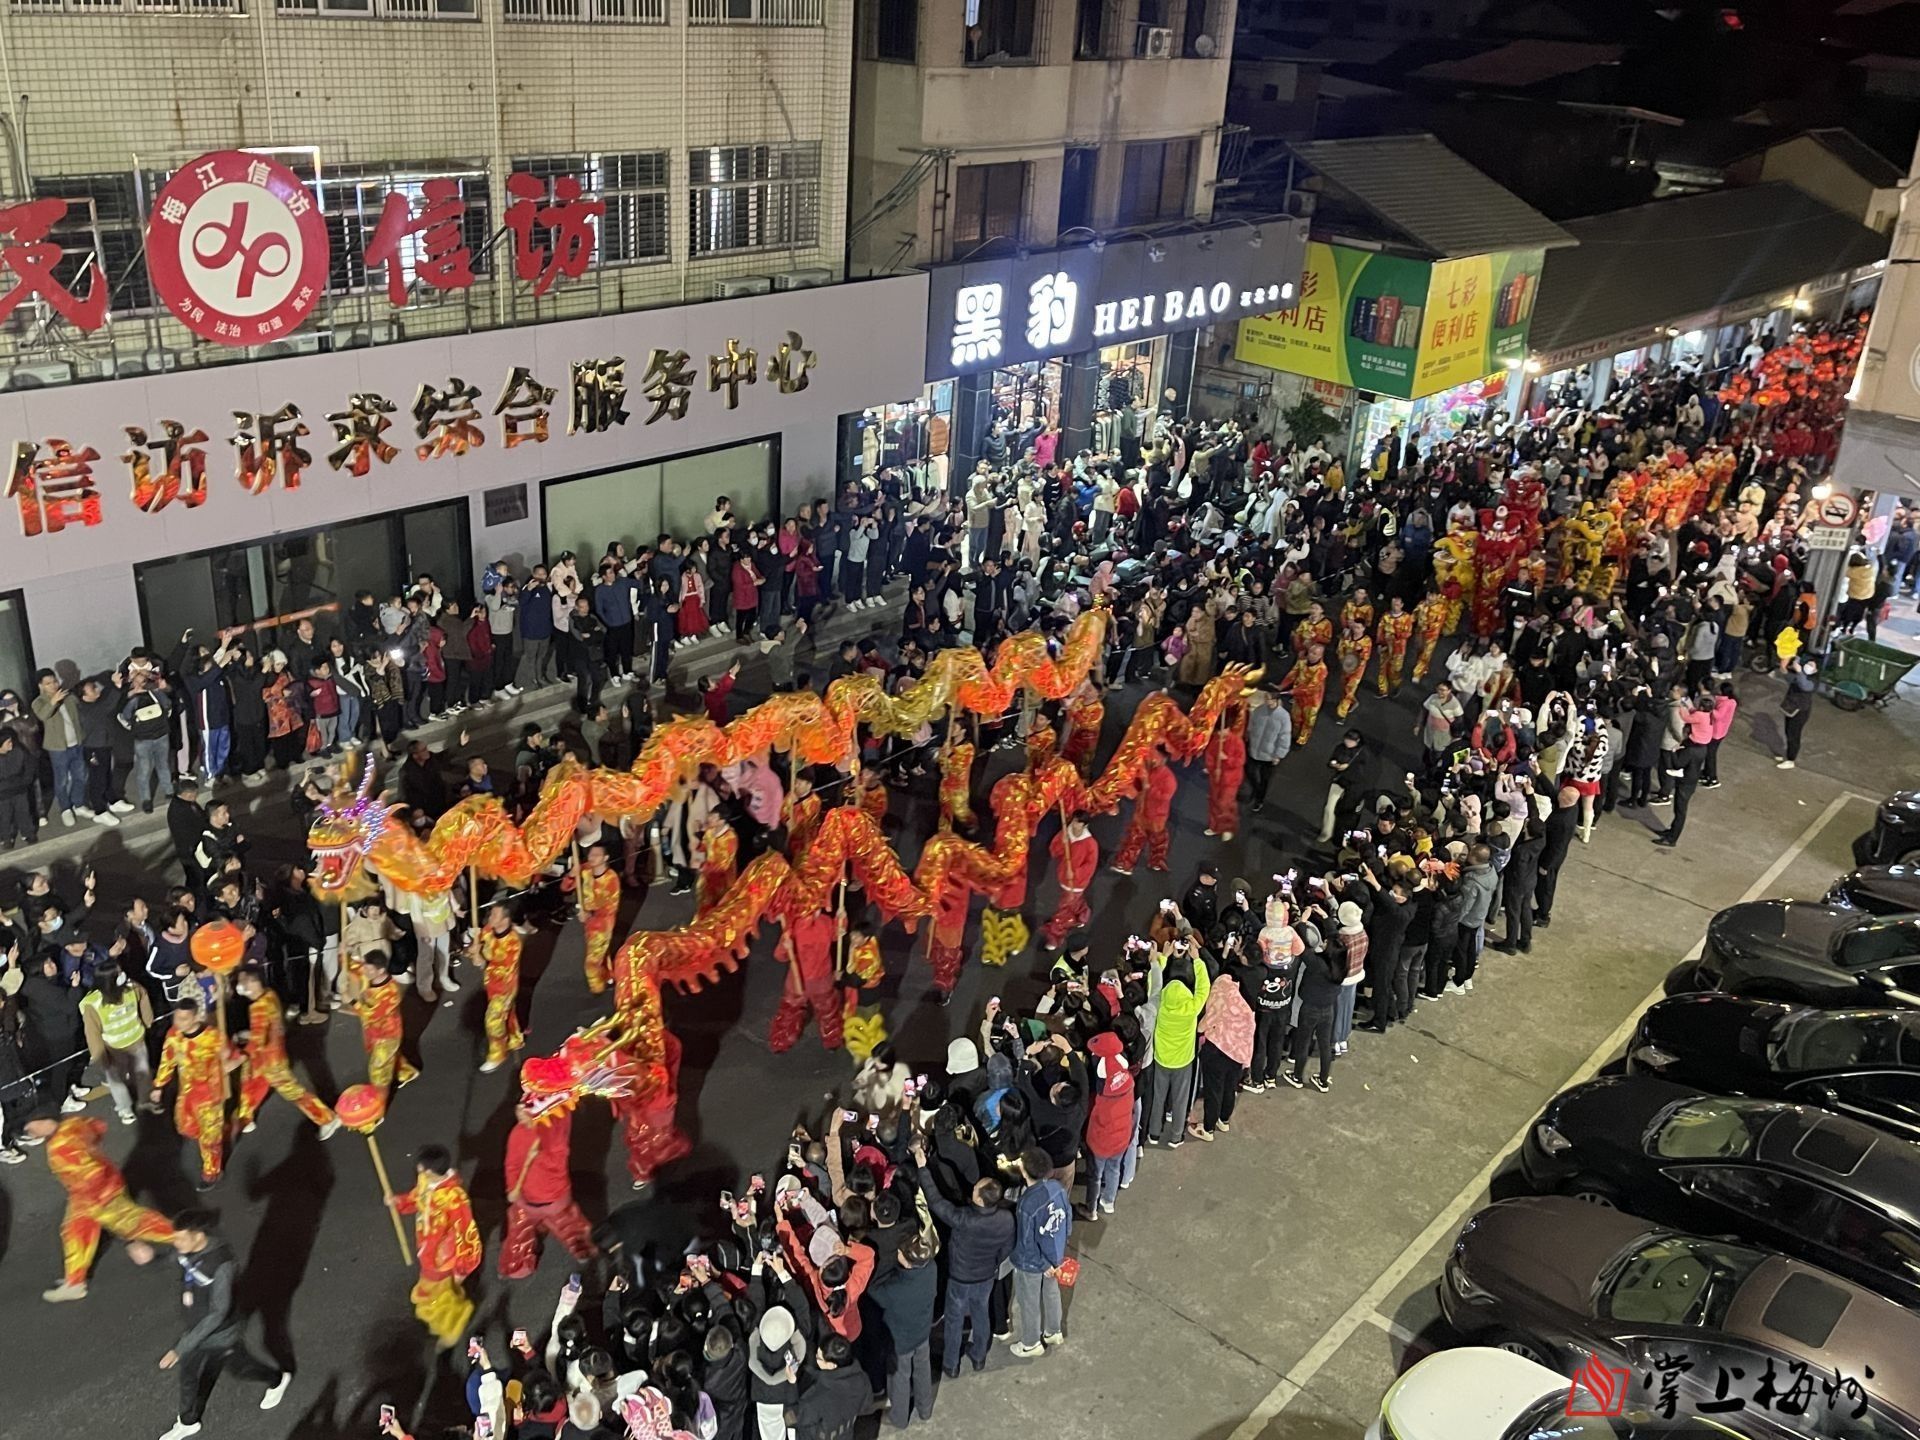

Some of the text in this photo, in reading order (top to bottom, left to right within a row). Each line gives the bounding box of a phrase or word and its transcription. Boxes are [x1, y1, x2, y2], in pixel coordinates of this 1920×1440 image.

[161, 159, 311, 225] 梅江信访
[365, 173, 606, 306] 信访
[178, 297, 206, 323] 为民
[214, 320, 241, 338] 法治
[951, 271, 1079, 367] 黑豹
[1093, 293, 1156, 337] HEI
[1162, 281, 1232, 324] BAO
[1255, 304, 1328, 334] 利店
[1446, 275, 1478, 310] 七彩
[1431, 310, 1480, 351] 便利店
[4, 329, 817, 537] 信访诉求综合服务中心
